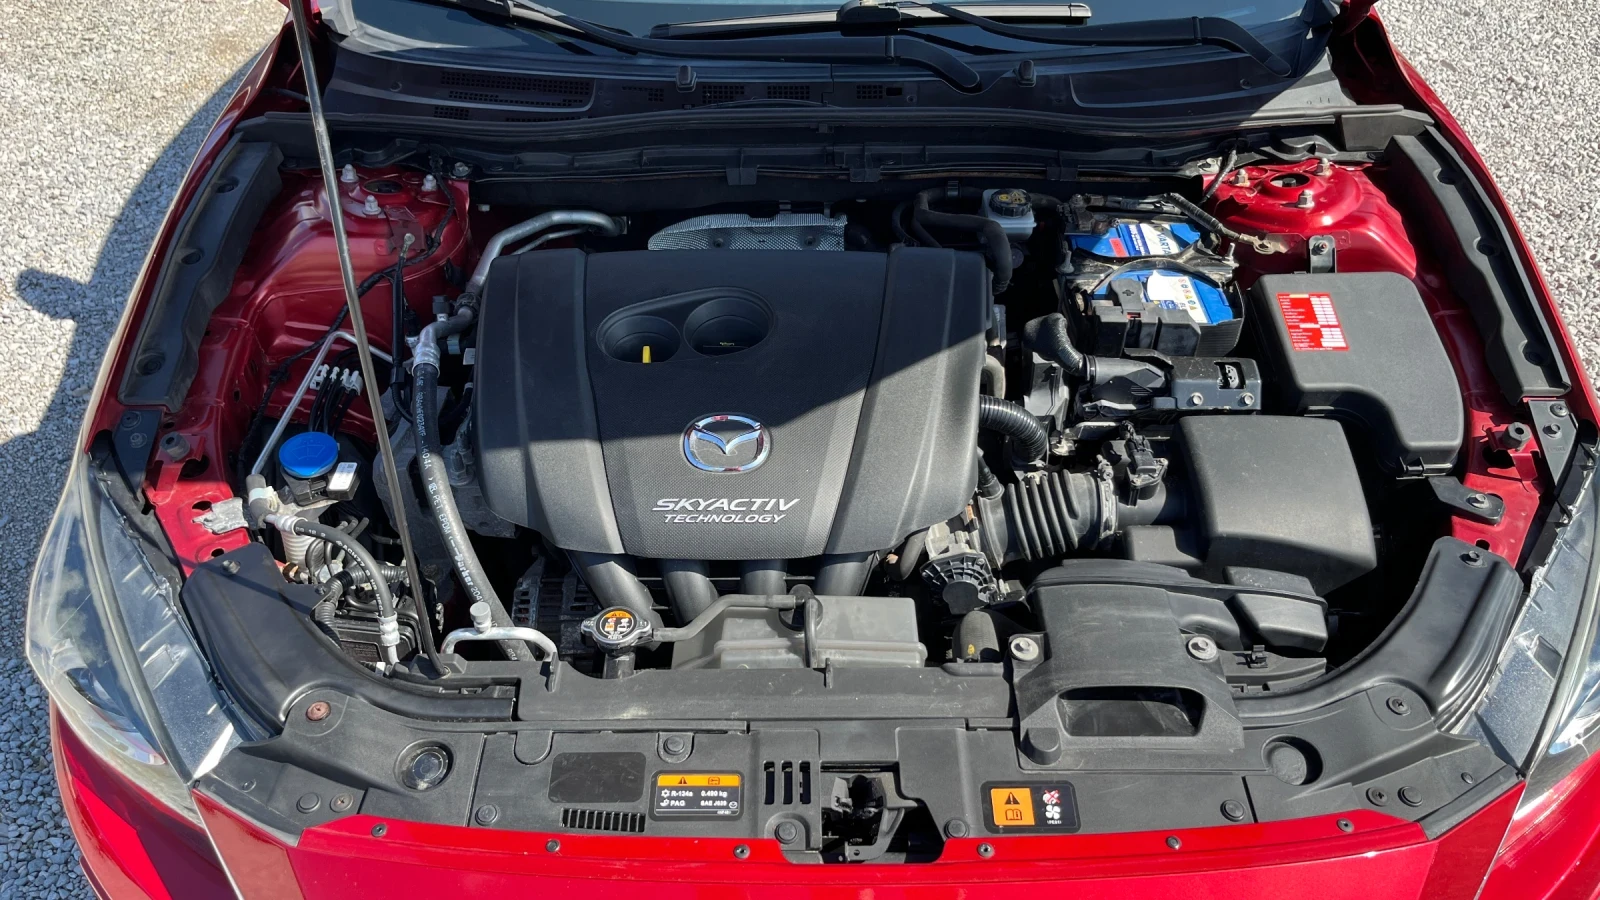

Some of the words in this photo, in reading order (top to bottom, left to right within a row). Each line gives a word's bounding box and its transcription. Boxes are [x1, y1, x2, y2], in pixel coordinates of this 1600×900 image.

[652, 498, 800, 511] SKYACTIV
[438, 515, 451, 534] EPDM
[664, 514, 786, 523] TECHNOLOGY
[455, 553, 474, 588] Parker
[719, 790, 728, 798] kg
